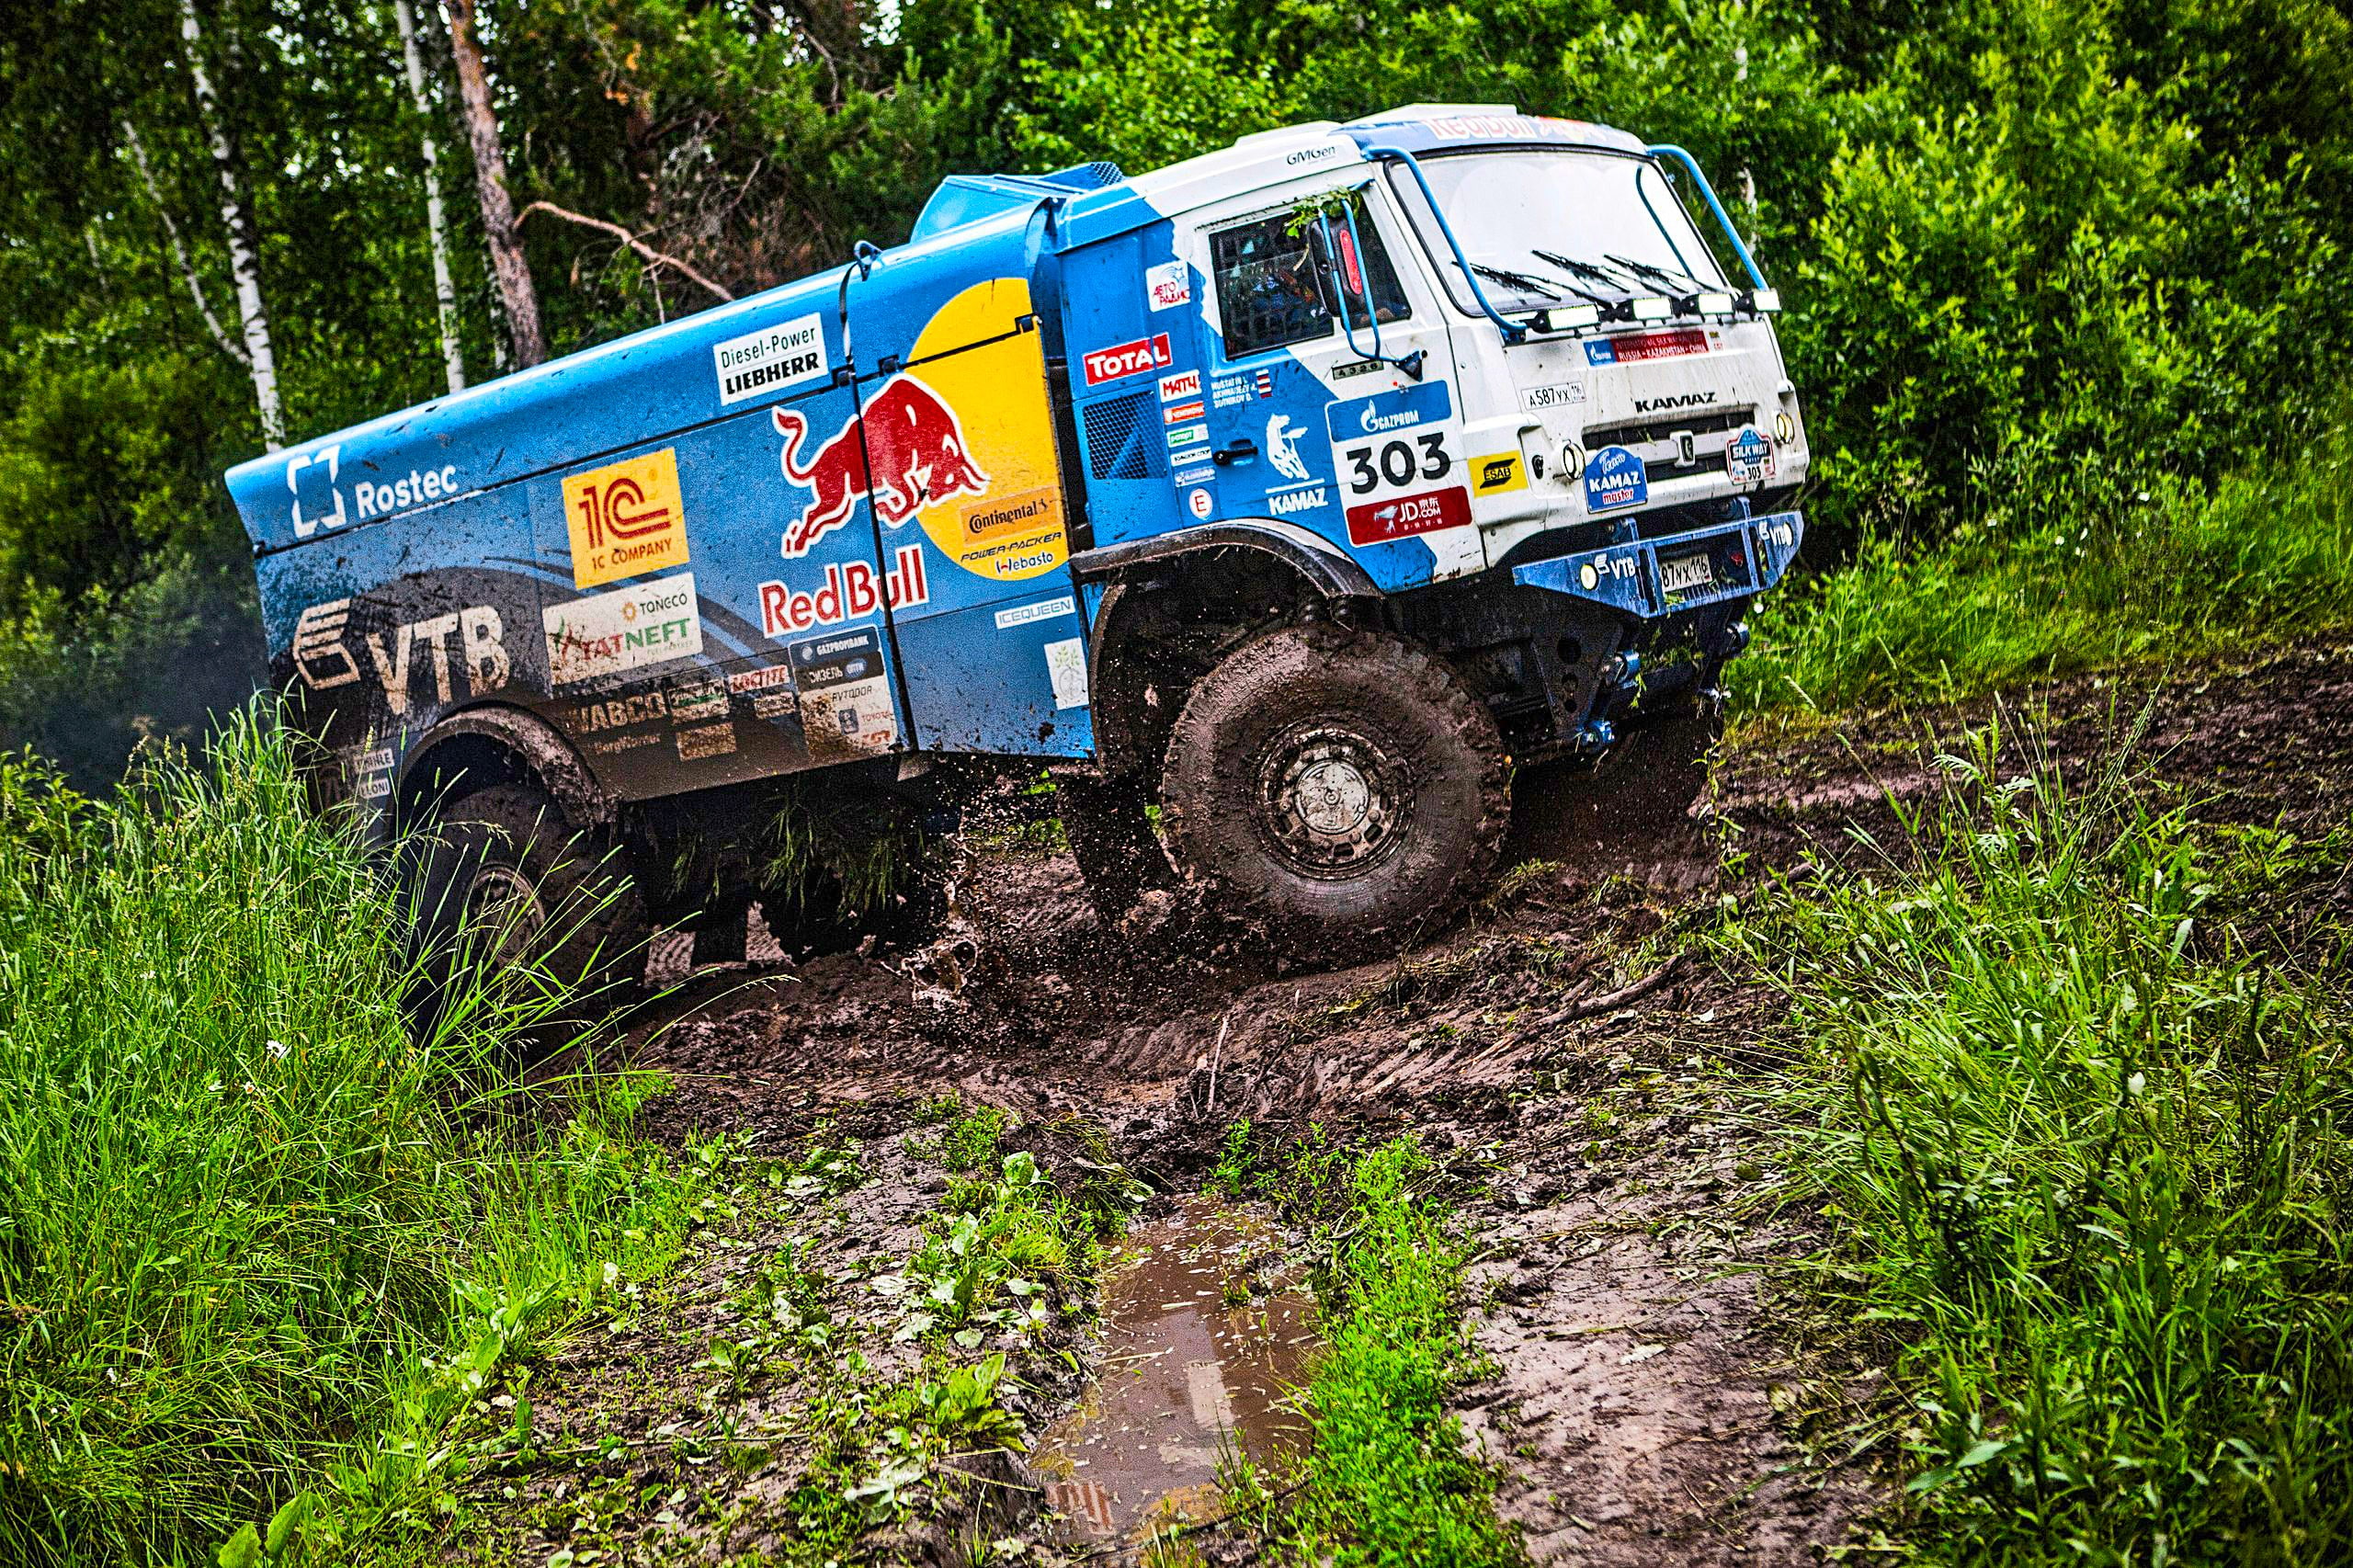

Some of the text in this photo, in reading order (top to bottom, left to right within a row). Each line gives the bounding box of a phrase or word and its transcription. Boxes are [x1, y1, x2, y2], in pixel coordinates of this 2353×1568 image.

[1287, 146, 1336, 165] GMGen
[722, 327, 814, 369] Diesel-Power
[726, 352, 819, 394] LIEBHERR
[1087, 346, 1168, 378] TOTAL
[1635, 392, 1718, 414] KAMAZ
[1379, 410, 1419, 430] GAZPROM
[1347, 432, 1451, 494] 303
[1733, 442, 1768, 460] SILK WAY
[1483, 467, 1512, 480] ESAB
[1589, 472, 1641, 493] KAMAZ
[1747, 466, 1761, 480] 303
[355, 465, 459, 518] Rostec
[1268, 487, 1328, 516] KAMAZ
[1603, 488, 1633, 505] master
[970, 500, 1038, 533] Continental
[611, 538, 673, 566] COMPANY
[995, 551, 1053, 574] Webasto
[1610, 557, 1636, 581] VTB
[998, 599, 1071, 625] ICEQUEEN
[580, 618, 691, 661] TATNEFT
[816, 634, 869, 655] GAZPROMBANK
[366, 604, 510, 715] VTB
